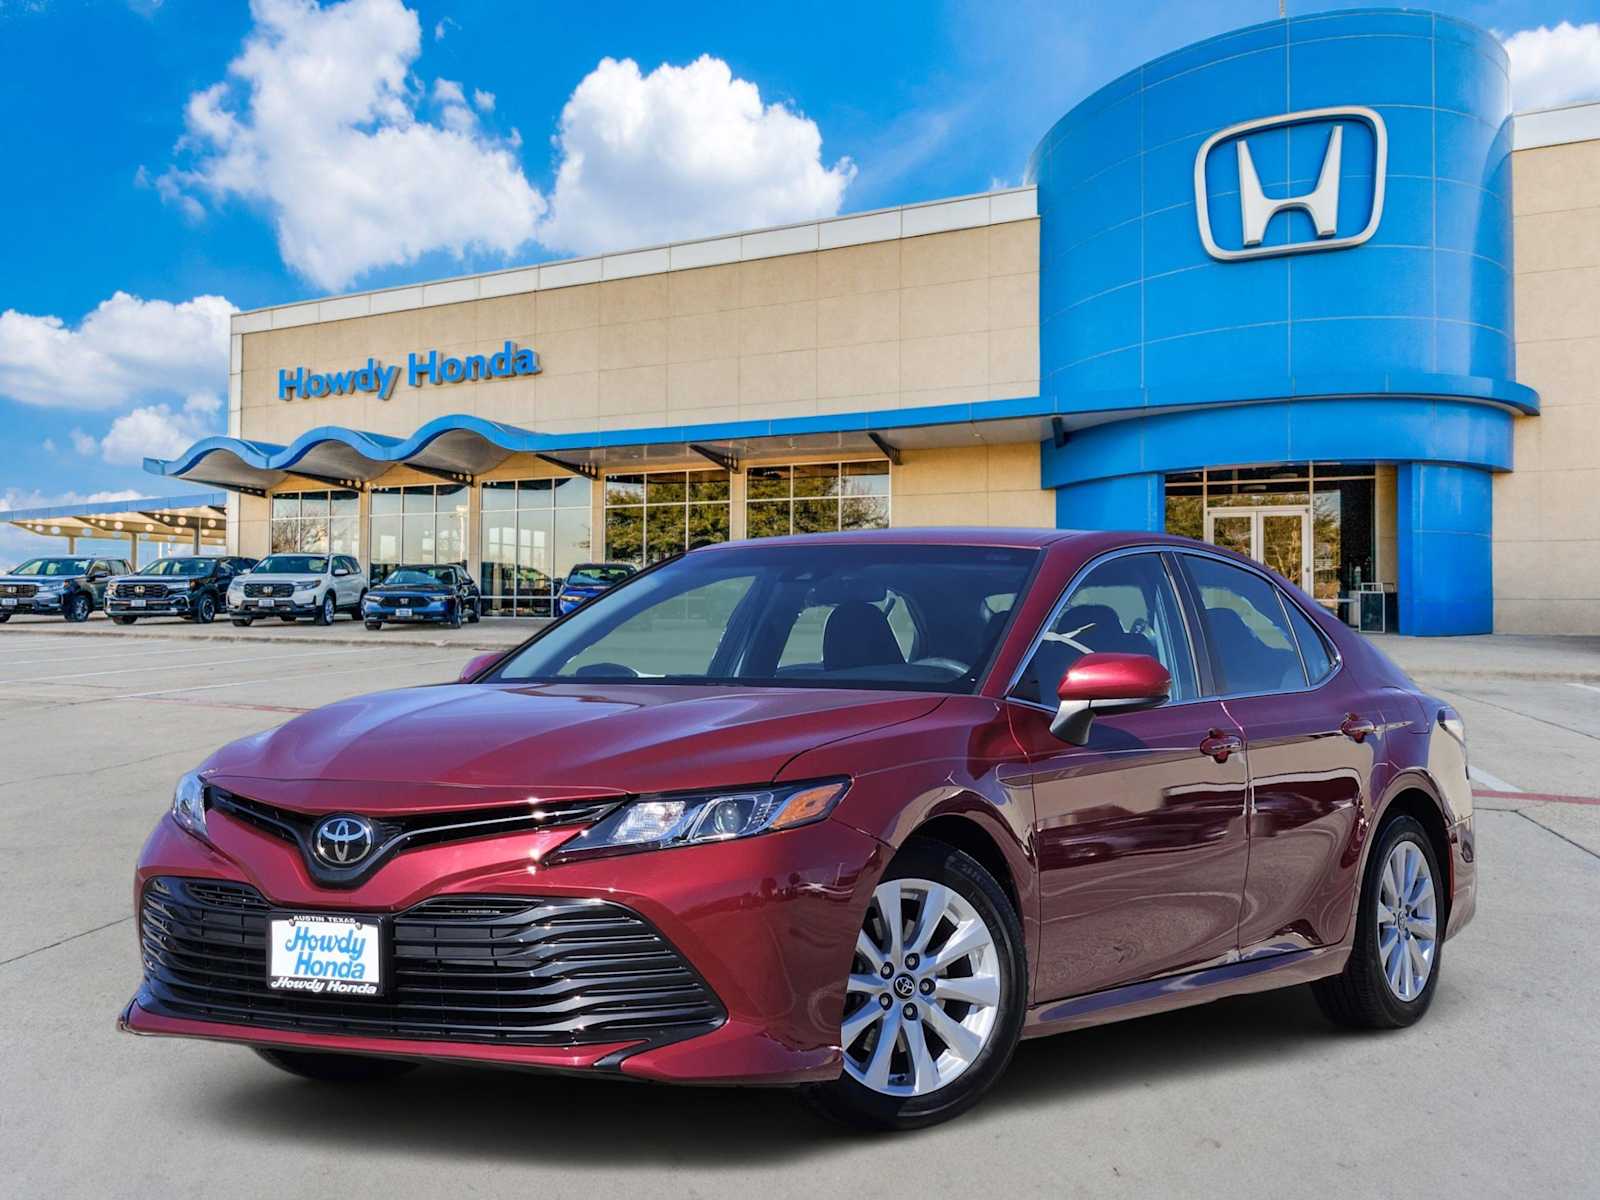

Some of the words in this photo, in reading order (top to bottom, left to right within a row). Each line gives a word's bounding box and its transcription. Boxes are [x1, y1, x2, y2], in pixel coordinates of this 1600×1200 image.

[278, 358, 400, 401] Howdy
[407, 340, 541, 387] Honda
[285, 926, 367, 961] Howdy
[294, 951, 366, 979] Honda
[271, 977, 325, 992] Howdy
[326, 981, 377, 994] Honda
